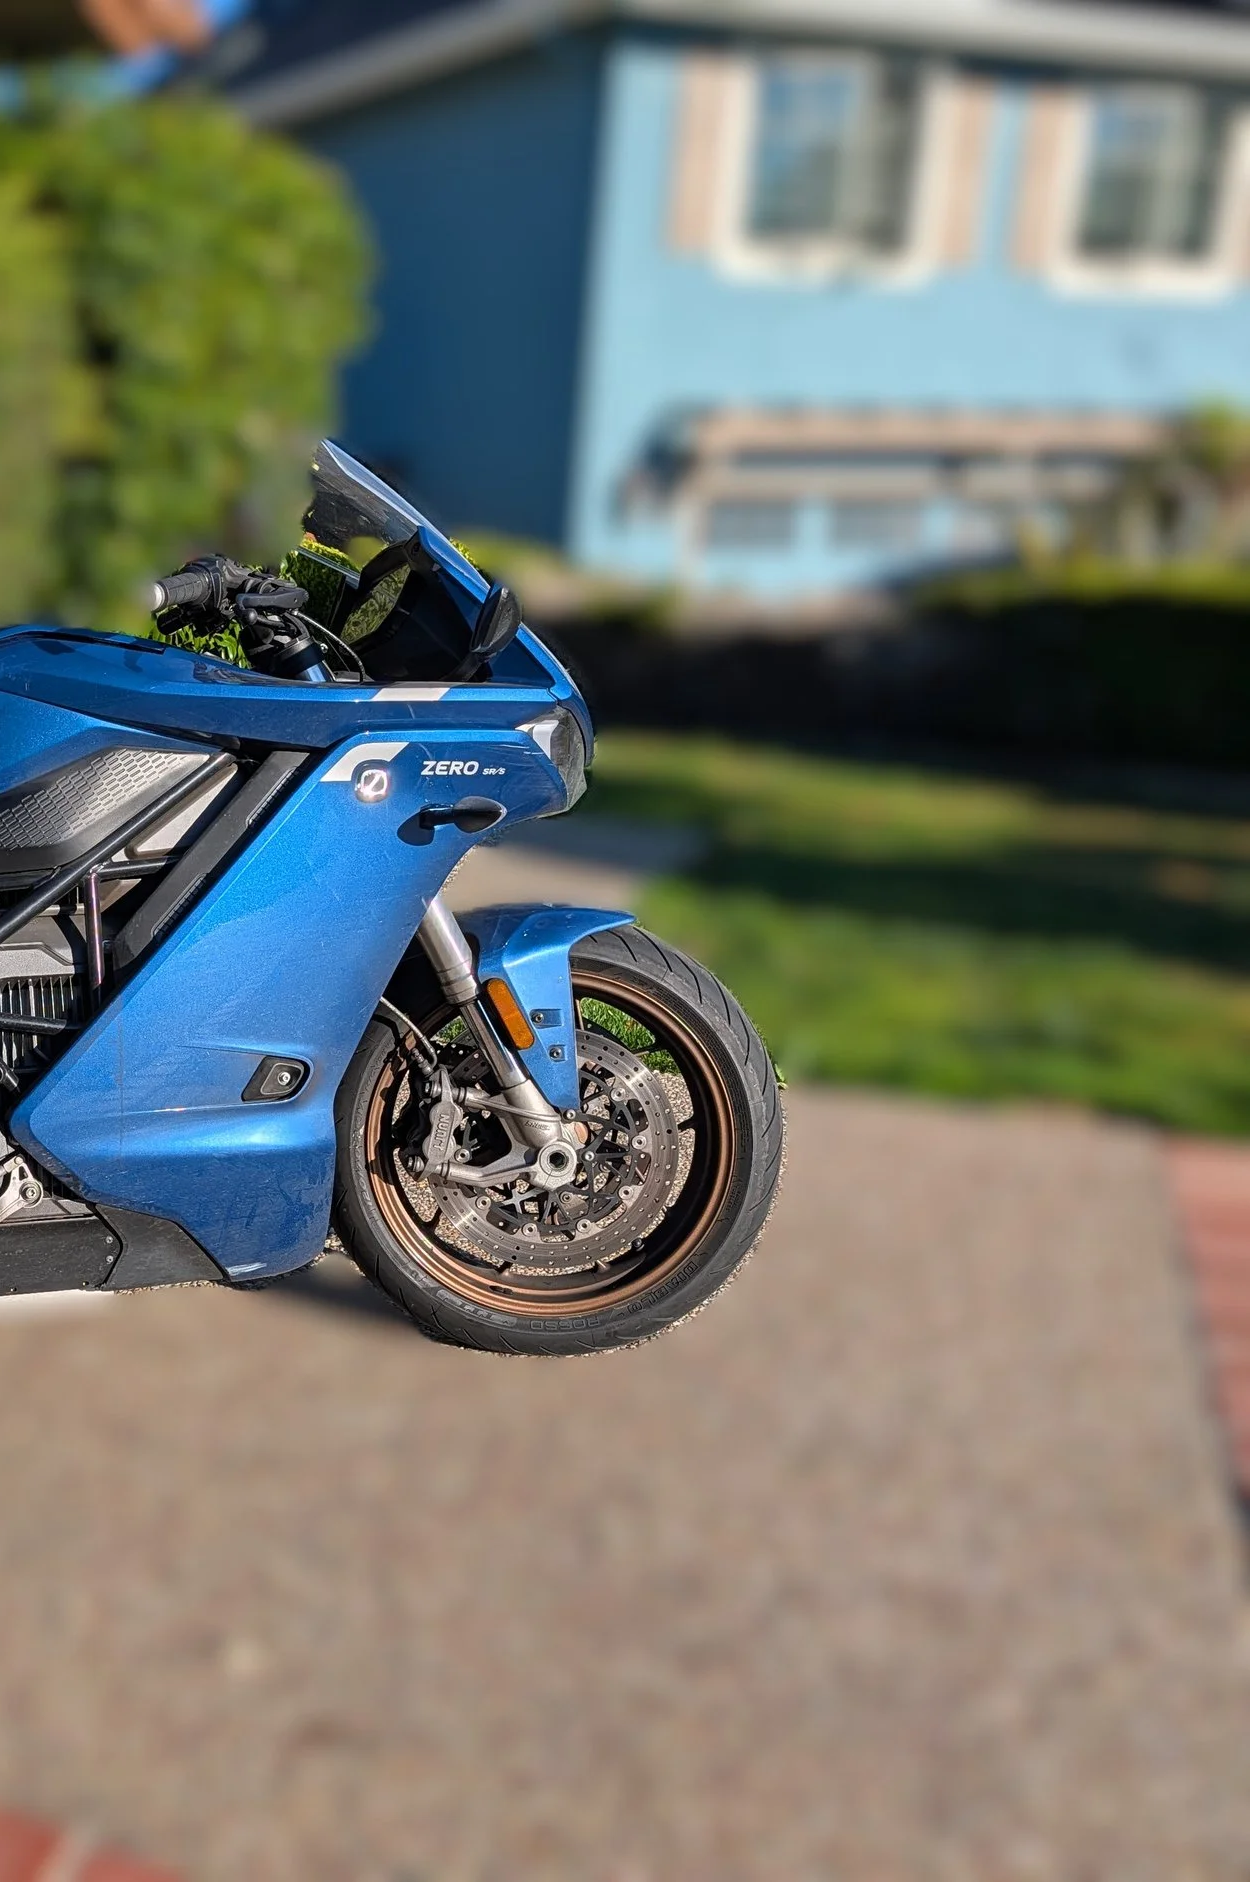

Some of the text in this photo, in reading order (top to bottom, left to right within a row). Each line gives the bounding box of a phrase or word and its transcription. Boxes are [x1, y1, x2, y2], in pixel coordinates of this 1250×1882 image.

[421, 761, 505, 775] ZERO SR/S
[627, 1260, 698, 1314] DIABLO
[530, 1317, 599, 1331] ROSSO
